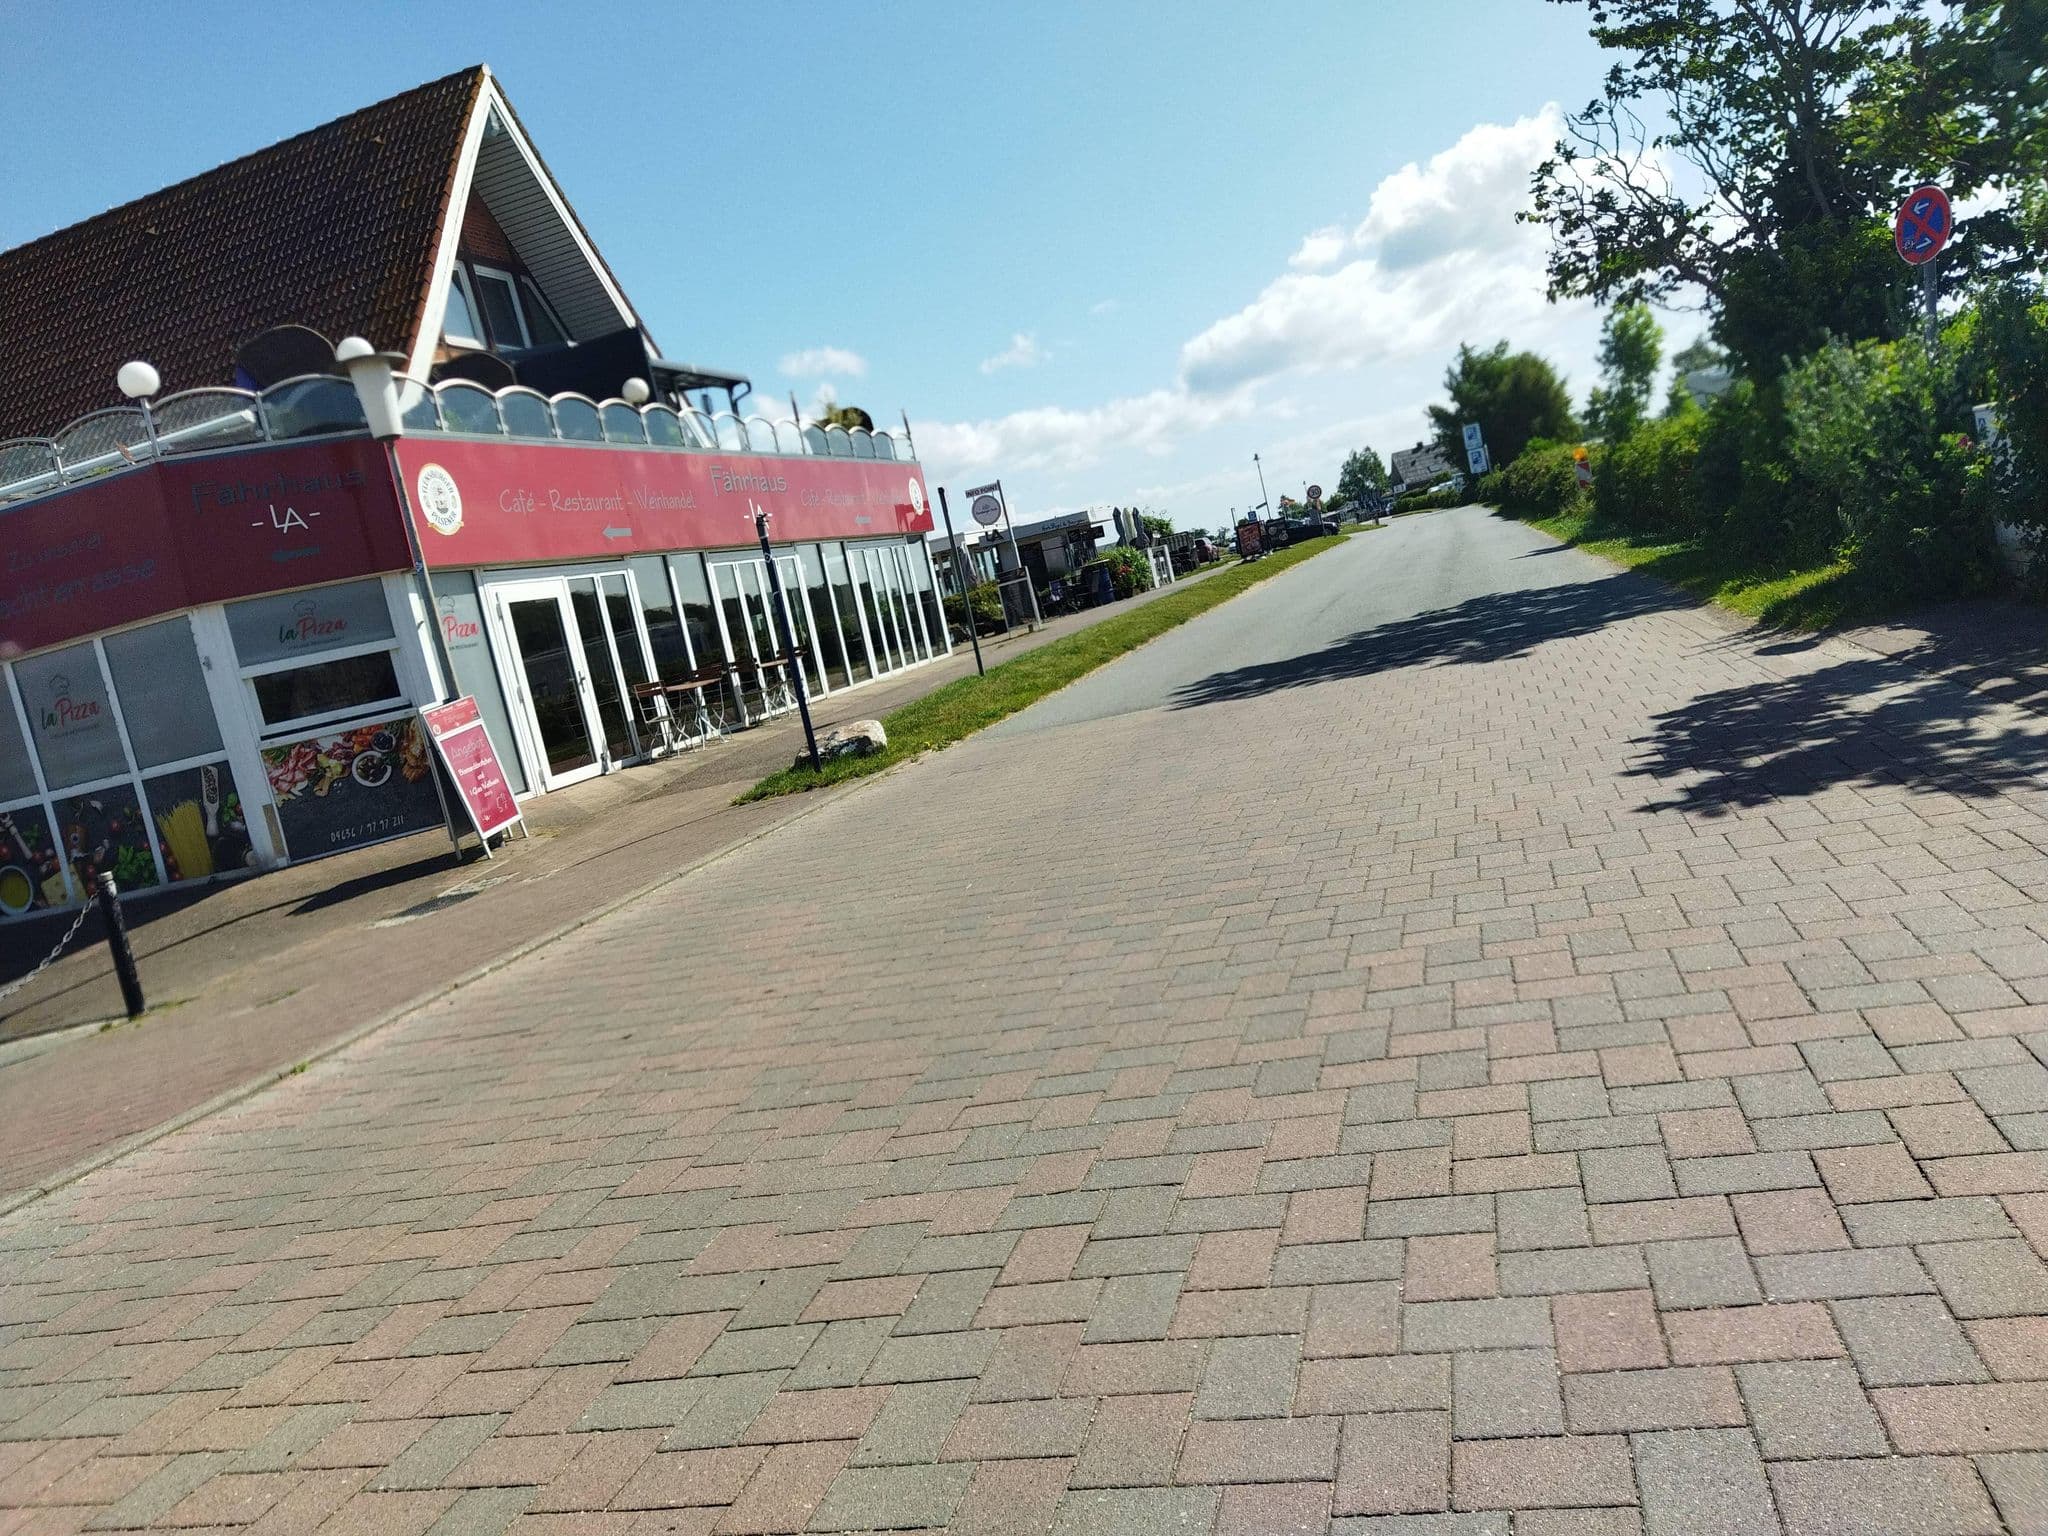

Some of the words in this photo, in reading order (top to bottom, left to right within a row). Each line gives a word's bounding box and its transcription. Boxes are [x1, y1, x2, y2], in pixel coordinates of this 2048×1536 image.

[709, 464, 788, 496] Fährhaus
[499, 489, 535, 515] Café
[549, 488, 624, 512] Restaurant
[297, 614, 347, 640] Pizza
[442, 615, 479, 643] Pizza
[55, 697, 99, 728] Pizza
